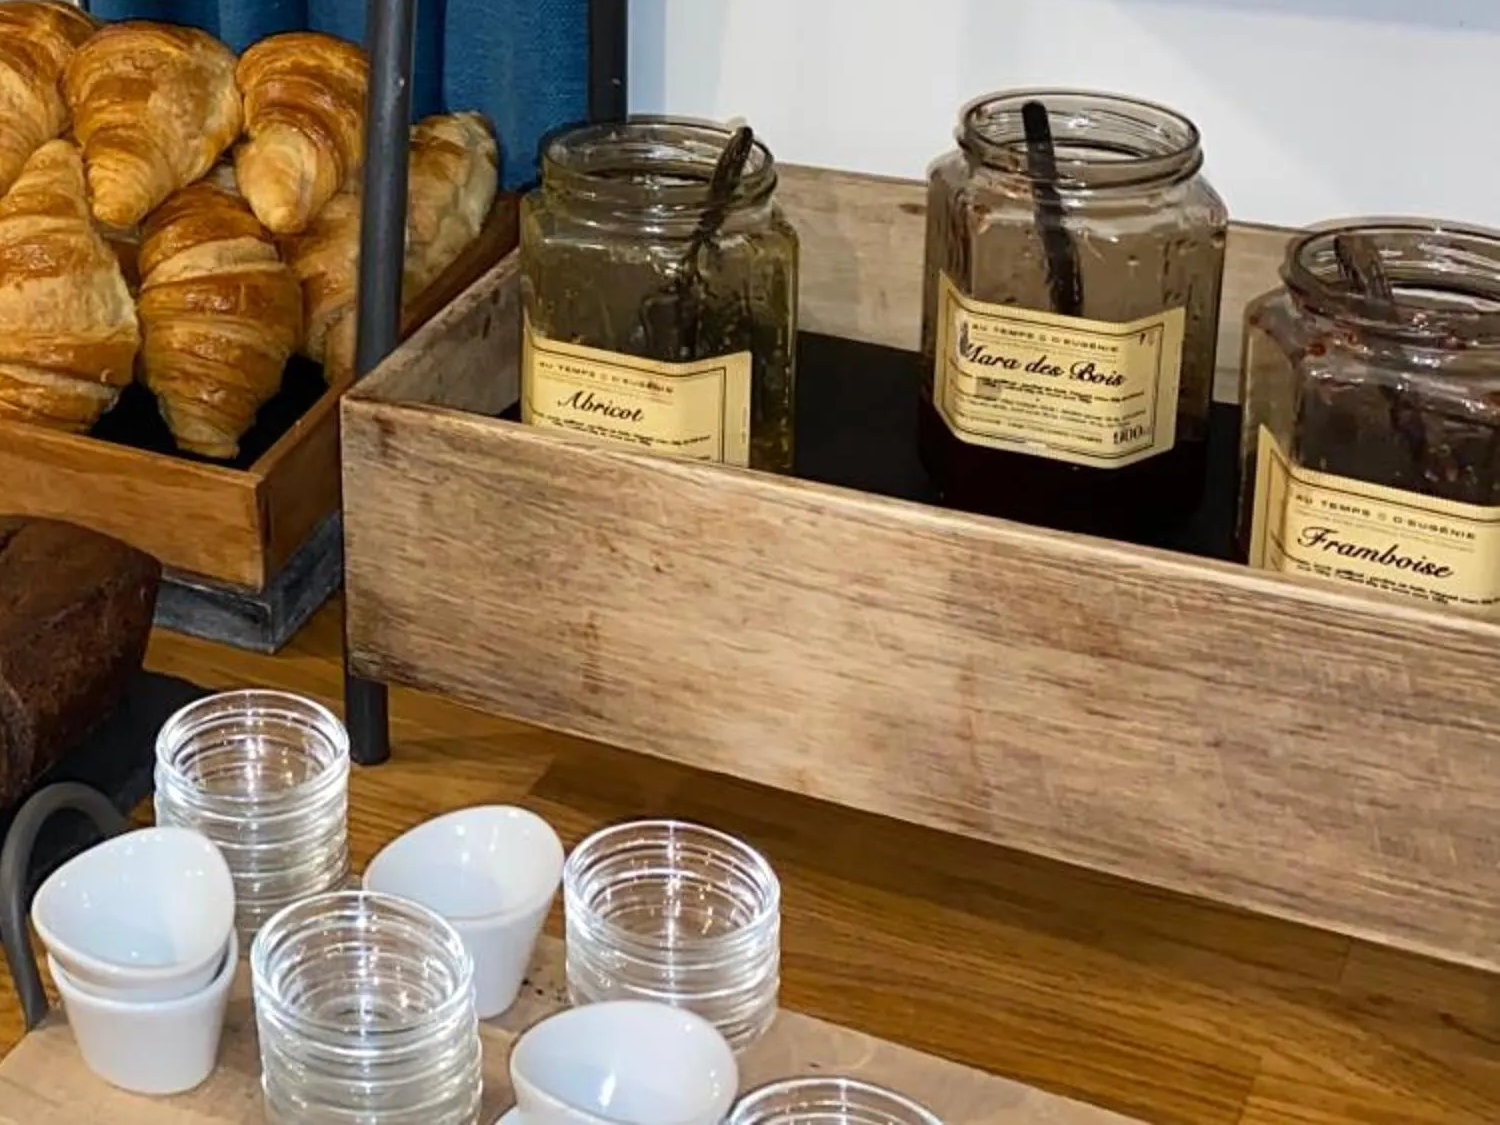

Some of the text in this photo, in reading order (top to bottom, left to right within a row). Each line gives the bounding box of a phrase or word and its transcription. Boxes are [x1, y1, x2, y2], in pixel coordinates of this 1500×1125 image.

[1025, 354, 1065, 377] des
[1069, 360, 1128, 386] Bois
[557, 390, 644, 422] Abricot
[1320, 499, 1371, 518] TEMPS
[1297, 526, 1454, 579] Framboise
